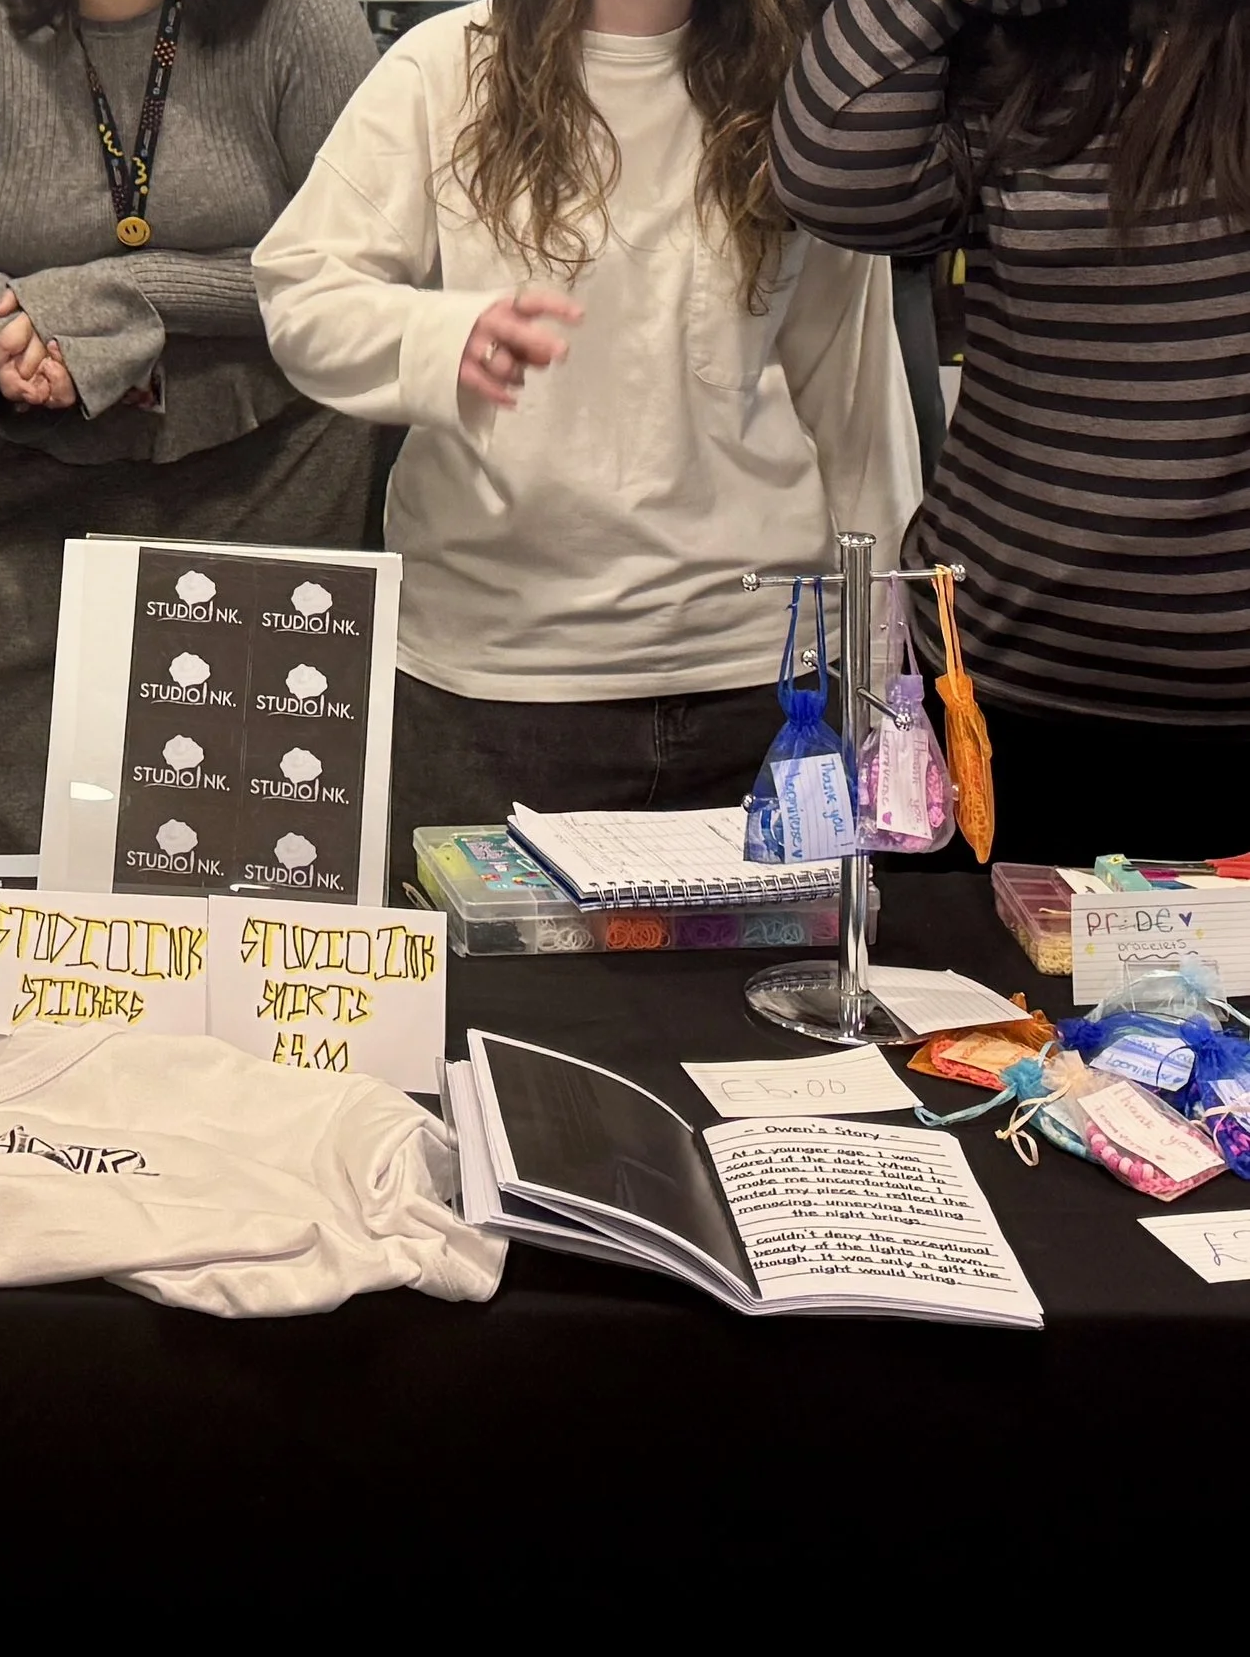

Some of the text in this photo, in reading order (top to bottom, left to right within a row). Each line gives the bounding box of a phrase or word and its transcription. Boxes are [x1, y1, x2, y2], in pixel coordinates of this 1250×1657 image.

[820, 757, 839, 805] Thank
[12, 974, 144, 1023] STICKERS
[765, 1123, 880, 1140] Owen's Story
[731, 1150, 749, 1160] At
[770, 1146, 831, 1155] younger
[891, 1154, 921, 1162] was
[724, 1155, 773, 1173] scared
[780, 1155, 794, 1163] of
[801, 1155, 826, 1163] the
[877, 1161, 922, 1173] When
[724, 1171, 755, 1182] was
[831, 1167, 875, 1176] never
[881, 1170, 924, 1182] failed
[931, 1175, 947, 1184] to
[736, 1178, 777, 1191] make
[727, 1187, 969, 1207] wanted my piece to reflect the
[791, 1209, 819, 1217] the
[825, 1209, 867, 1220] night
[825, 1199, 903, 1213] unnerving
[909, 1204, 964, 1221] feeling
[753, 1243, 807, 1258] beauty
[814, 1241, 828, 1250] of
[836, 1241, 863, 1251] the
[870, 1243, 915, 1257] lights
[922, 1250, 938, 1260] in
[756, 1227, 991, 1256] couldn't deny the exceptional
[809, 1264, 852, 1275] night
[858, 1266, 906, 1278] would
[820, 1253, 835, 1261] It
[841, 1254, 873, 1263] was
[938, 1264, 966, 1274] gift
[972, 1267, 1000, 1279] the
